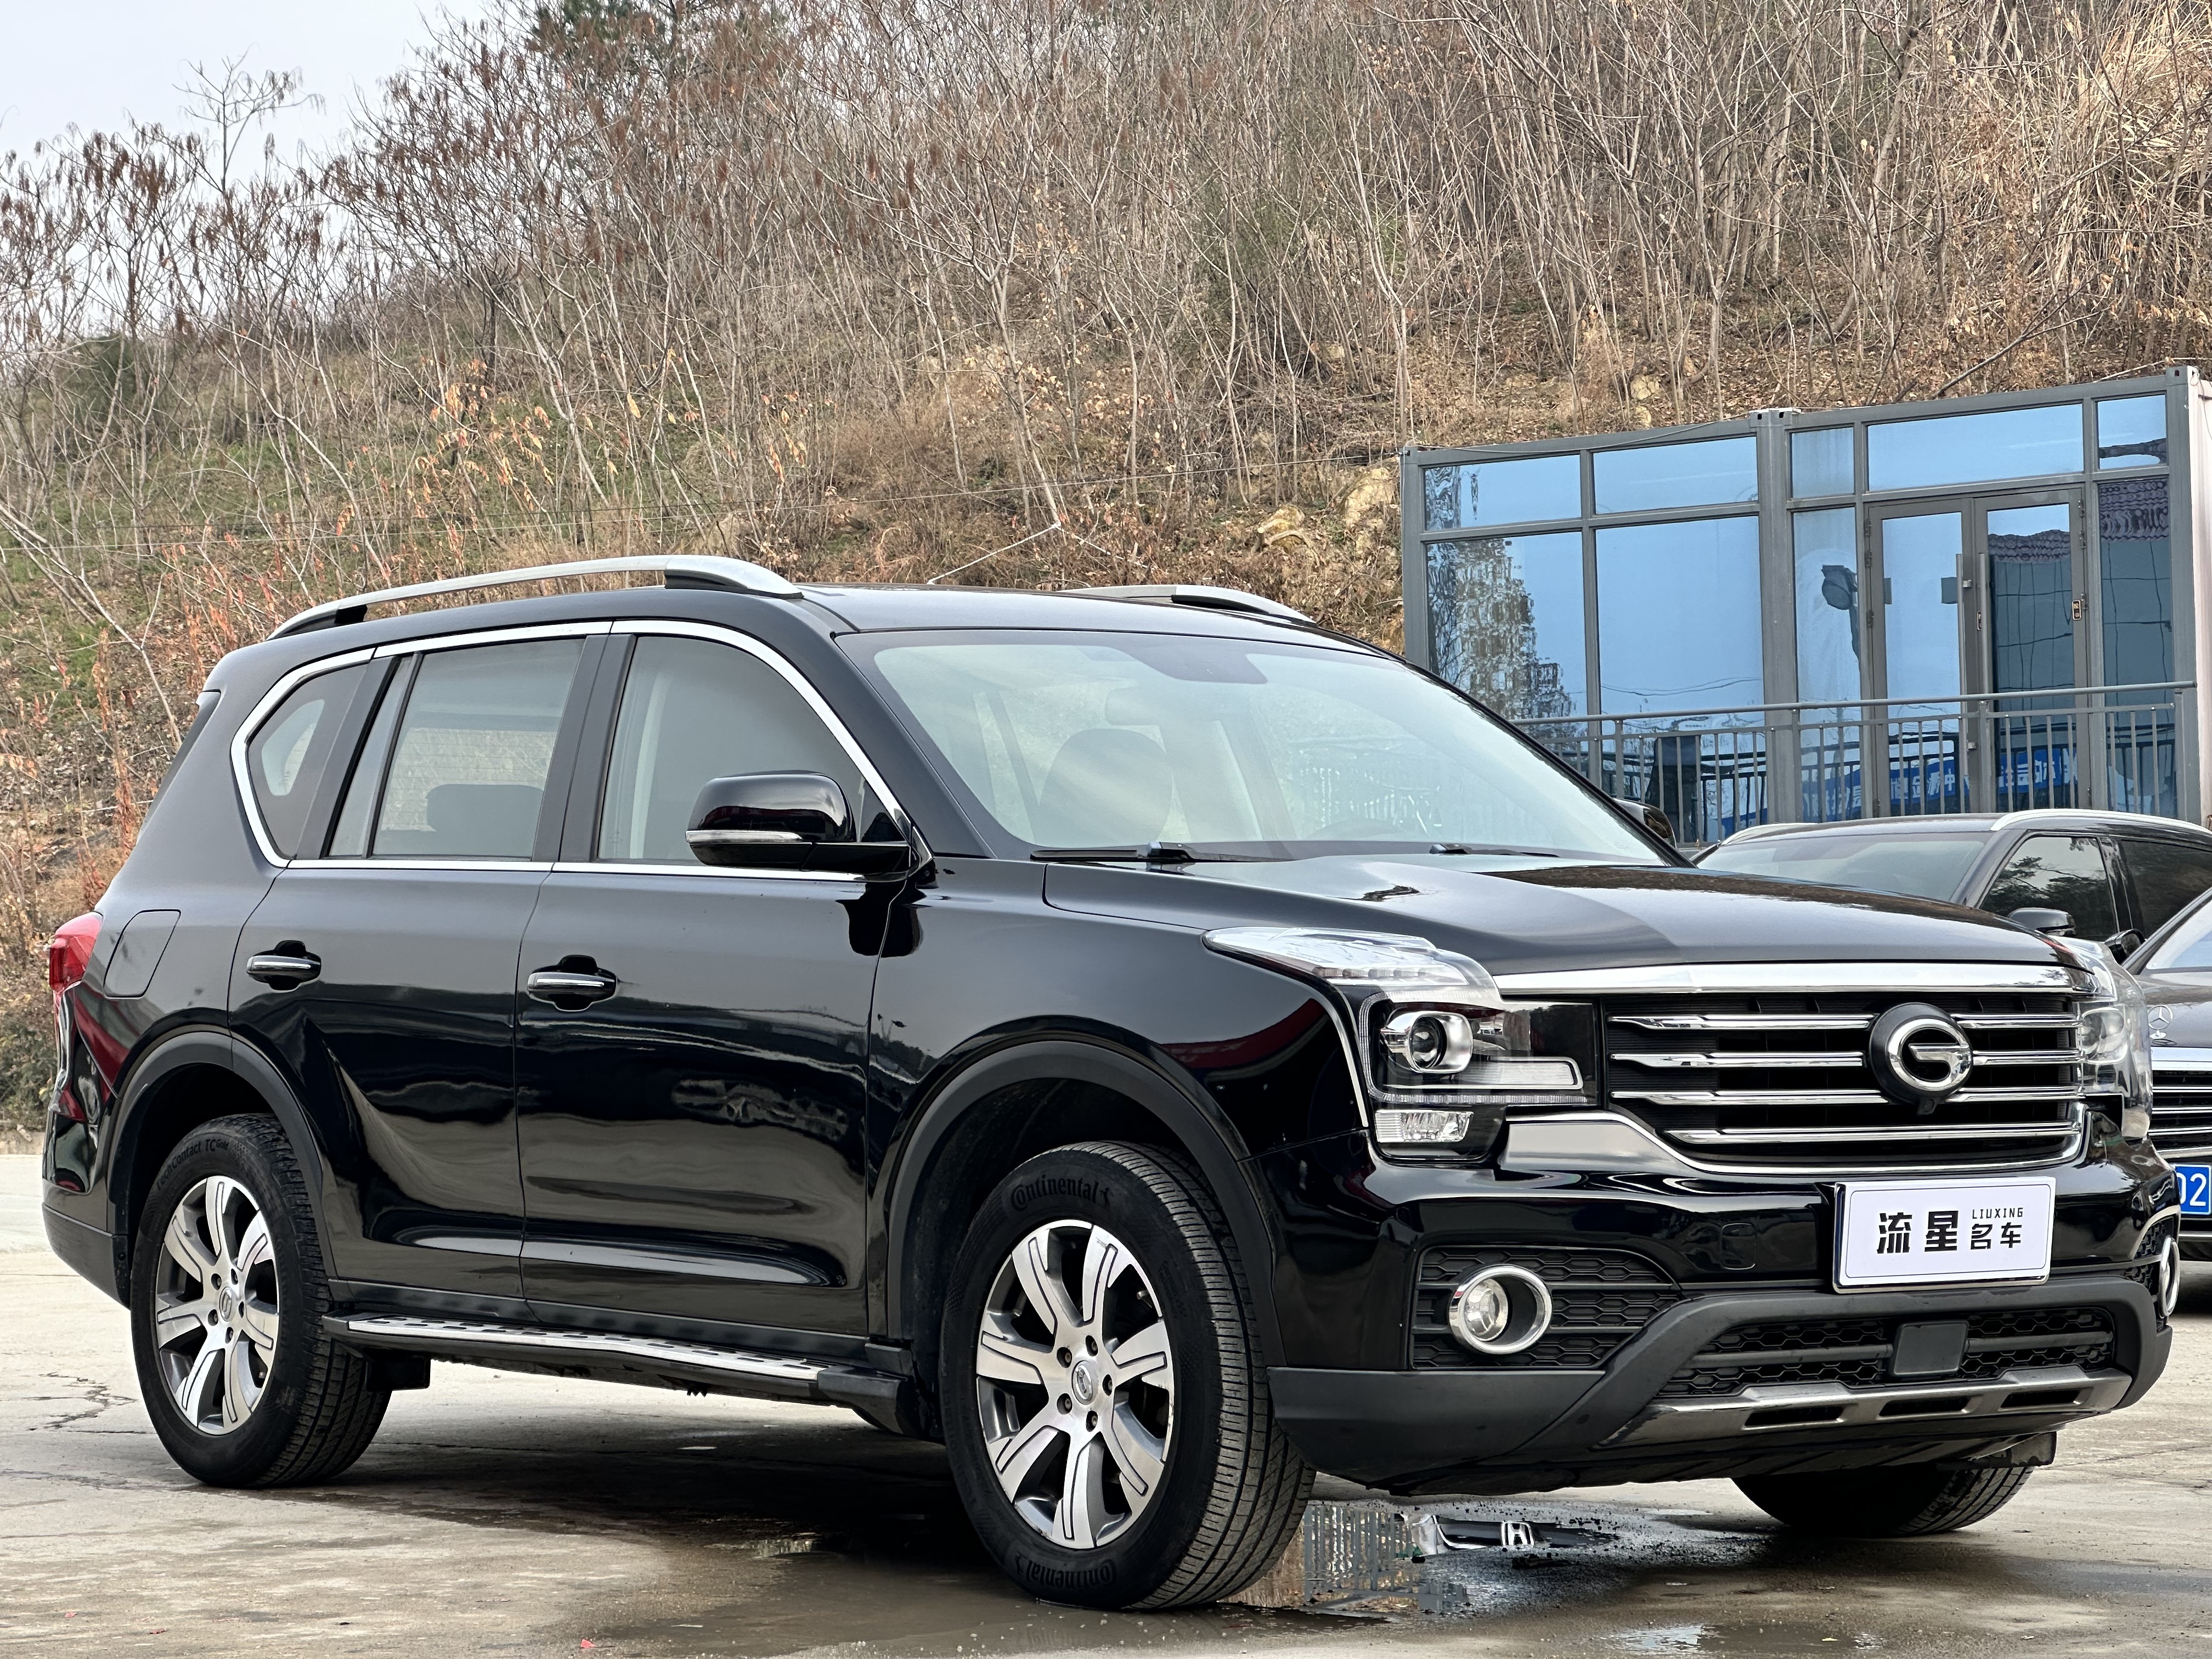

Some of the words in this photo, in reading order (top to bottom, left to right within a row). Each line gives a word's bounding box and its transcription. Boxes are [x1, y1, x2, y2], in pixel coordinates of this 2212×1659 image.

[1011, 1174, 1099, 1212] Continental
[1972, 1207, 2023, 1219] LIUXING
[1876, 1210, 1959, 1254] 流星
[1970, 1222, 2022, 1250] 名车
[1025, 1559, 1117, 1592] Continental
